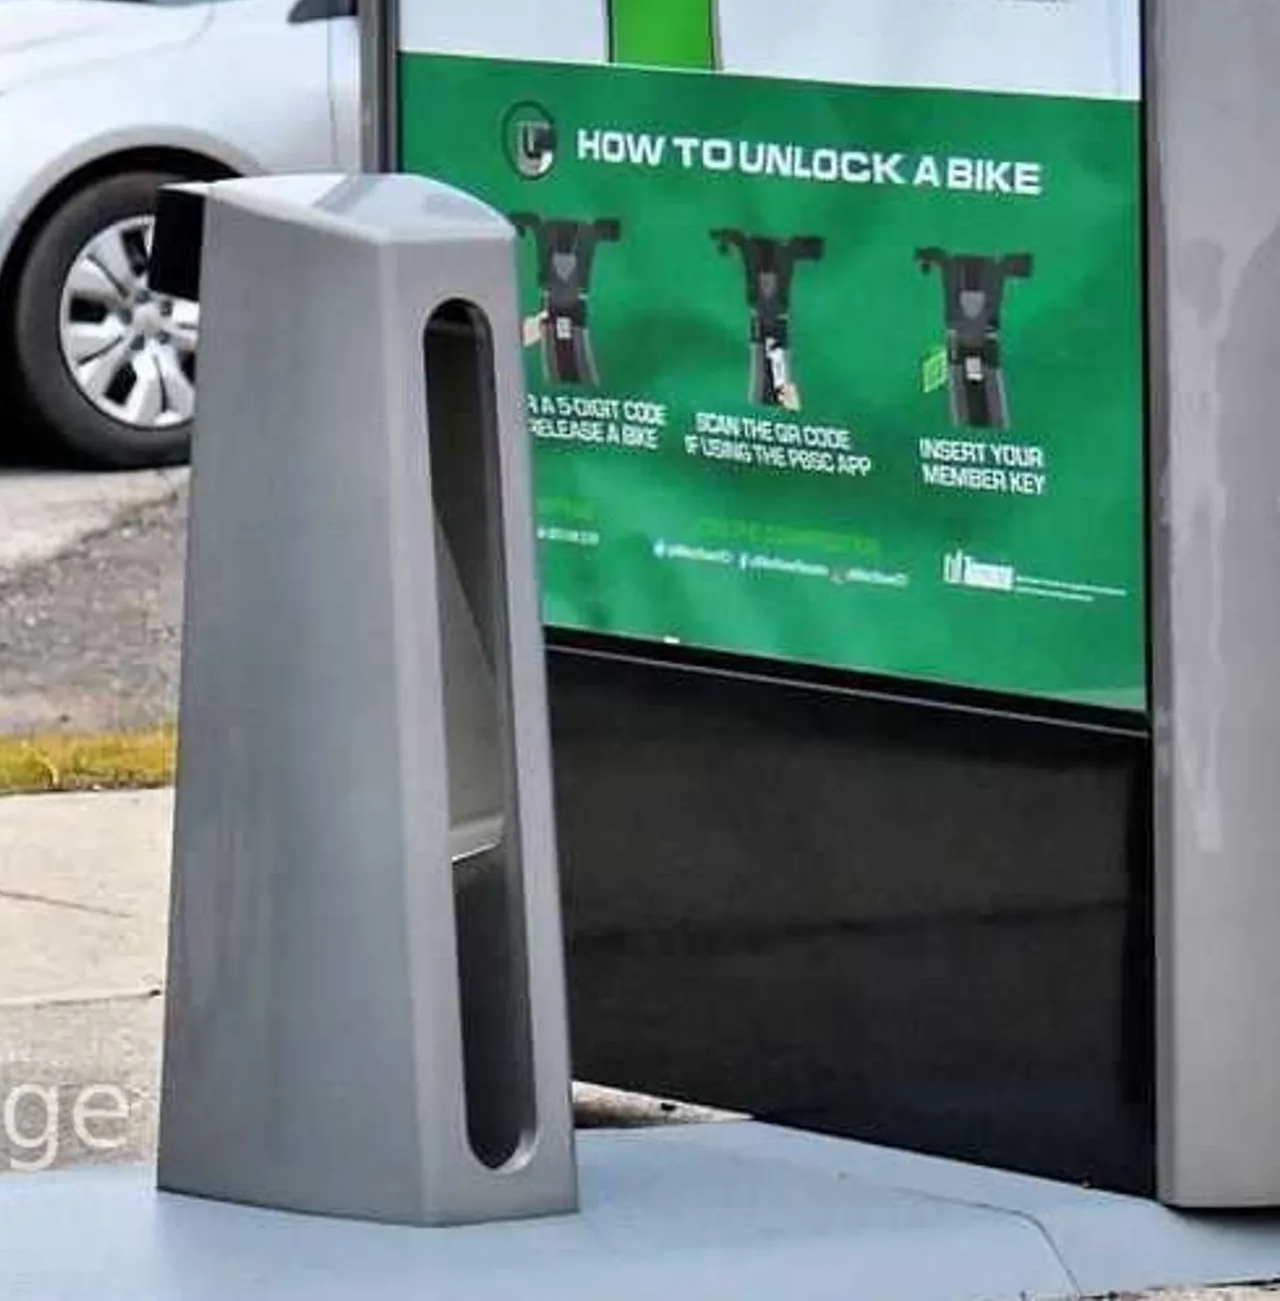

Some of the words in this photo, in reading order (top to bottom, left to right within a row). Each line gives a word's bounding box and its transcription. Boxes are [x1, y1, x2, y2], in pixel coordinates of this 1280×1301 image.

[577, 129, 665, 167] HOW
[672, 137, 734, 170] TO
[739, 143, 907, 185] UNLOCK
[912, 155, 941, 188] A
[945, 157, 1043, 195] BIKE
[540, 395, 557, 415] A
[622, 399, 669, 427] CODE
[605, 420, 622, 445] A
[621, 423, 660, 451] BIKE
[695, 411, 742, 437] SCAN
[742, 417, 775, 443] THE
[775, 421, 802, 447] QR
[802, 425, 852, 451] CODE
[701, 438, 753, 464] USING
[752, 443, 788, 469] THE
[836, 452, 874, 478] APP
[919, 437, 987, 463] INSERT
[989, 443, 1046, 469] YOUR
[920, 462, 1008, 492] MEMBER
[1009, 472, 1047, 496] KEY
